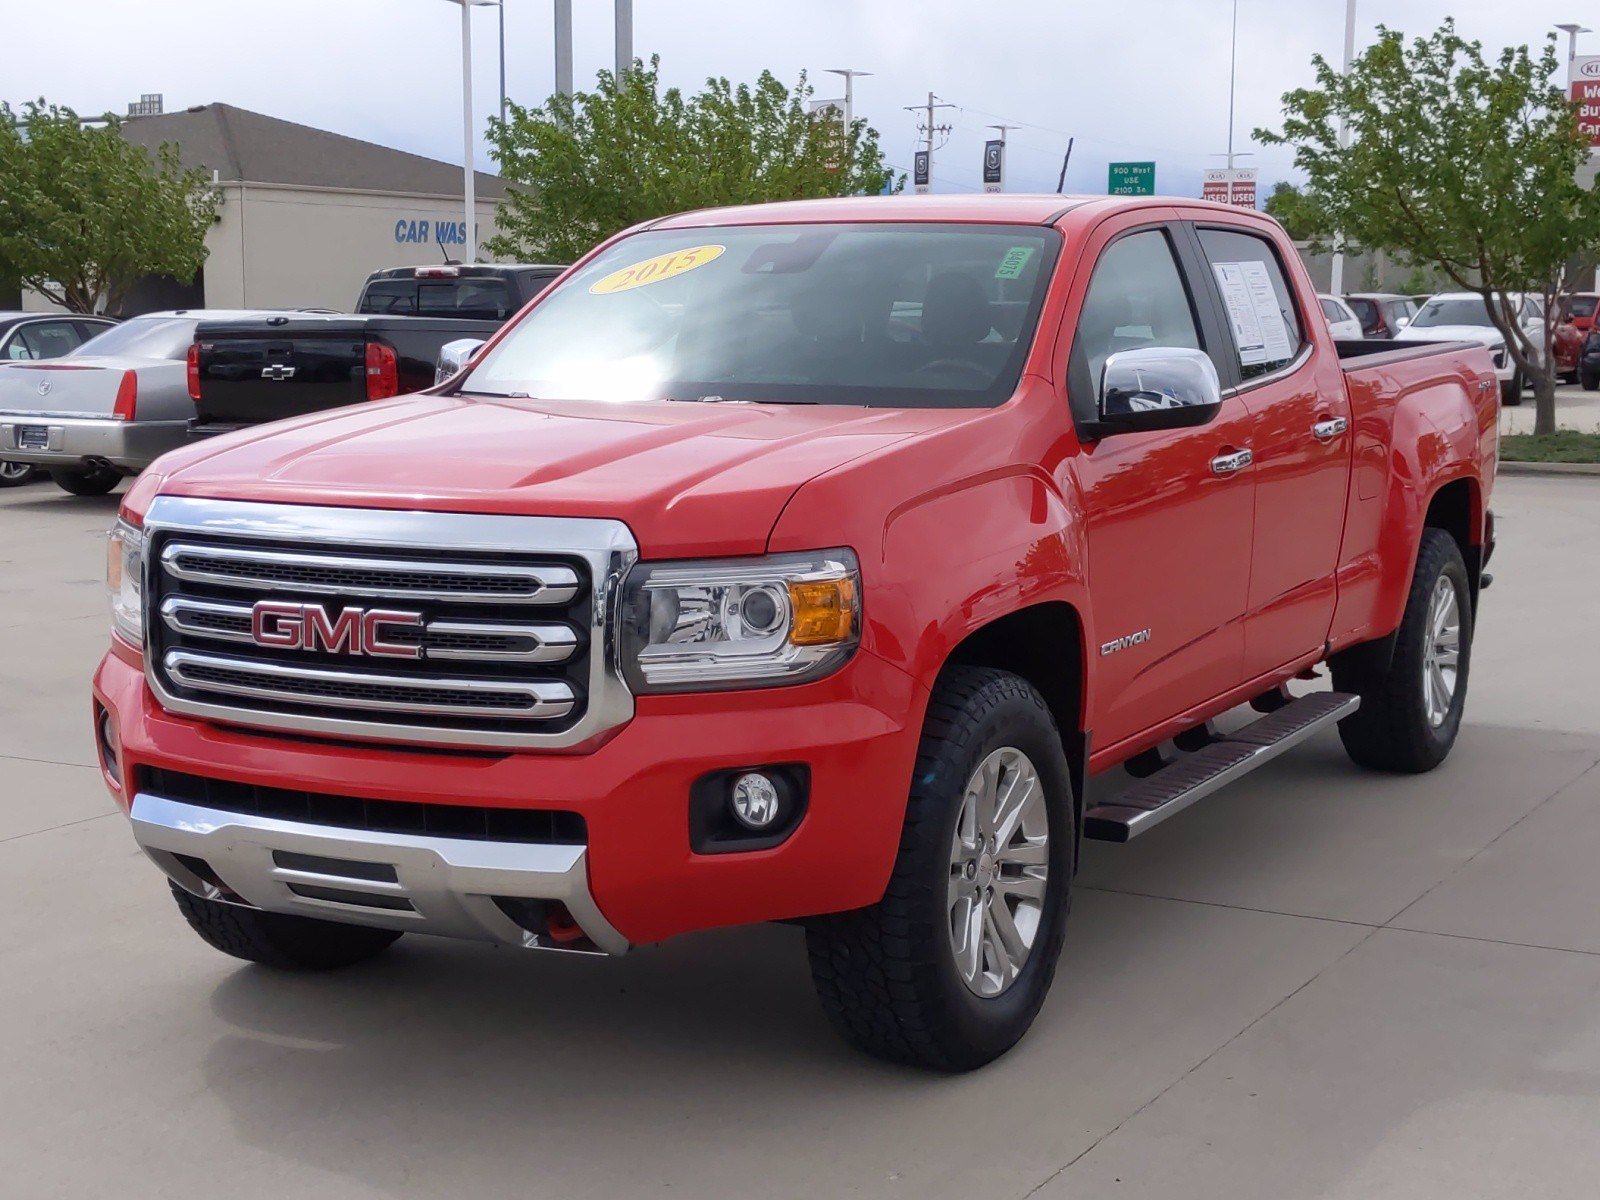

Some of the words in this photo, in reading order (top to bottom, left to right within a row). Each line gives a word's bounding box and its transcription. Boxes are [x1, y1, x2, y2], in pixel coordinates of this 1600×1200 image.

[1586, 64, 1600, 74] KI
[1132, 166, 1150, 174] West
[1123, 176, 1139, 184] USE
[1114, 186, 1133, 194] 2100
[1232, 193, 1254, 202] USED
[395, 219, 430, 243] CAR
[435, 221, 478, 245] WAS
[612, 249, 702, 290] 2015
[252, 600, 423, 660] GMC
[1100, 628, 1152, 657] CANYON
